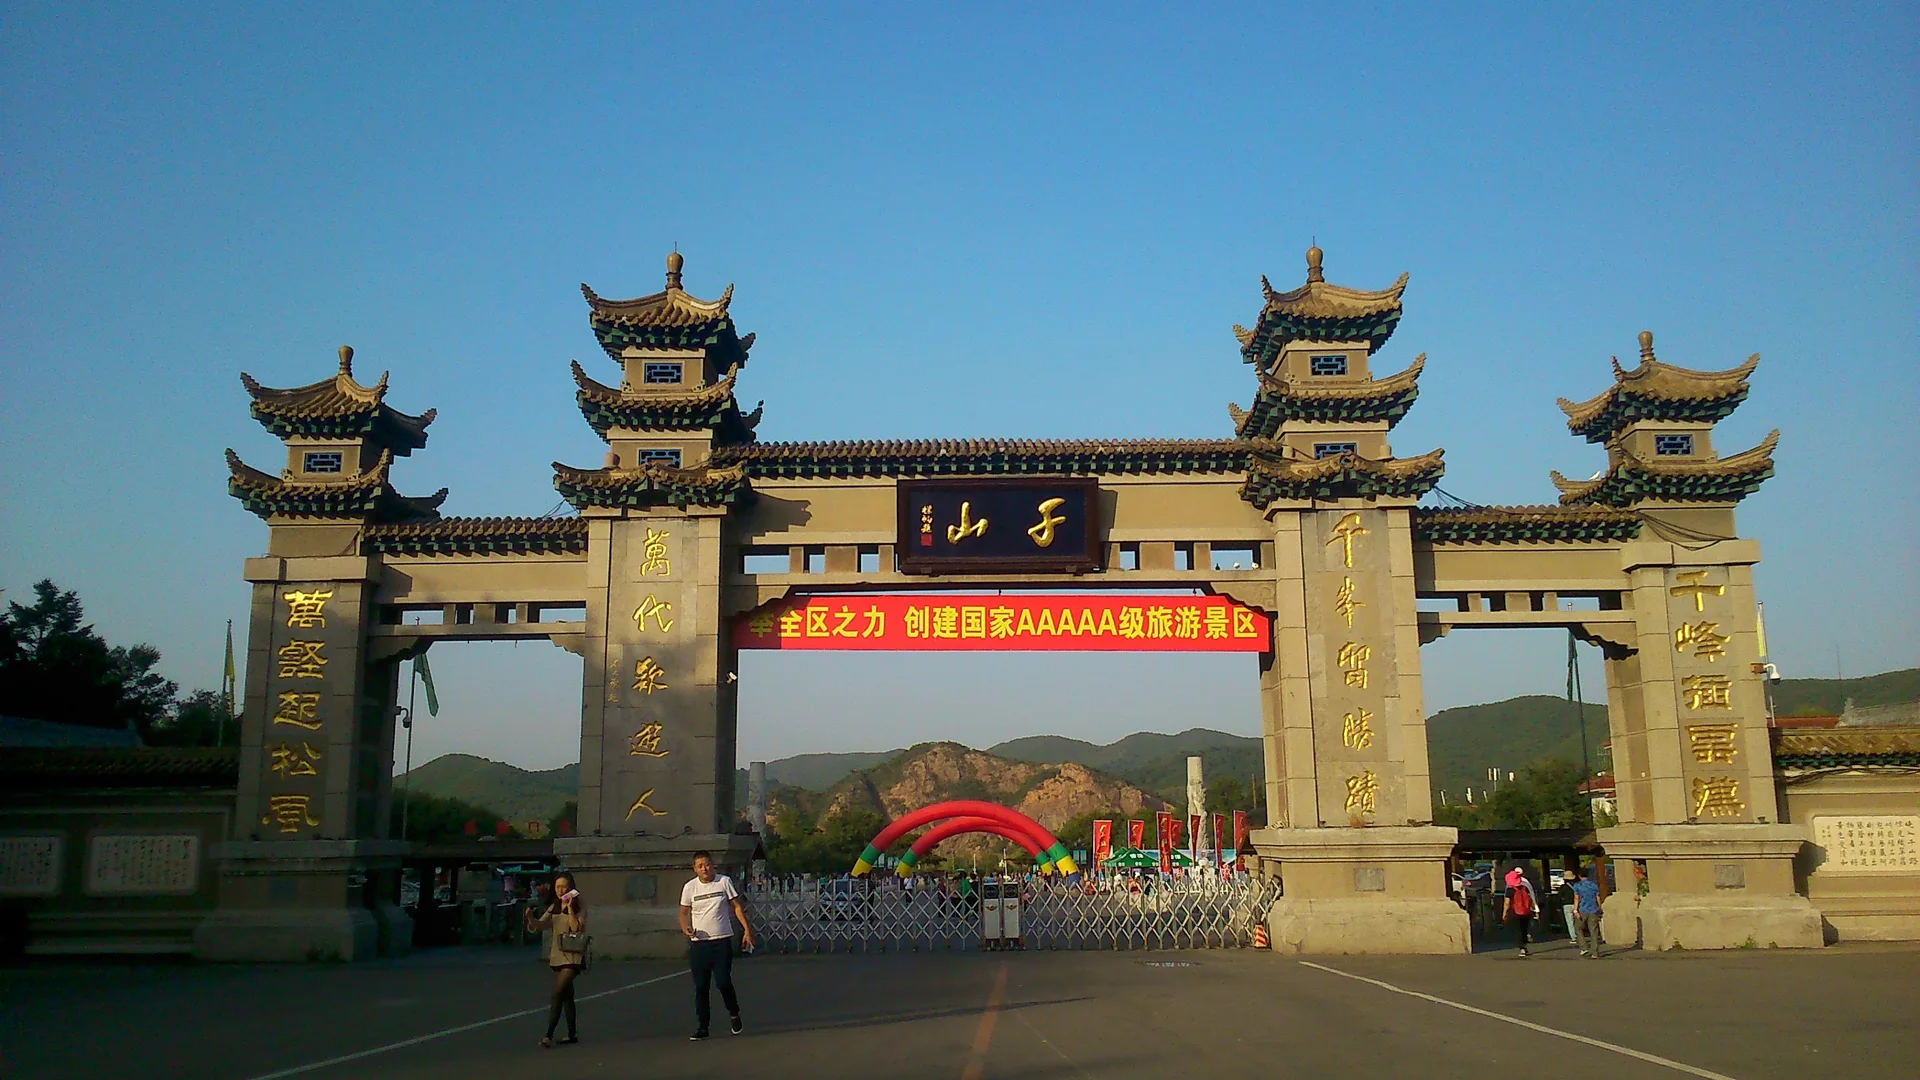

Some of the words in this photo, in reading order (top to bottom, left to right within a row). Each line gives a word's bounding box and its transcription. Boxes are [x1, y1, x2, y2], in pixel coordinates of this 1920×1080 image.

[749, 605, 886, 639] 举全区之力
[904, 605, 1259, 639] 创建国家AAAAA级旅游景区
